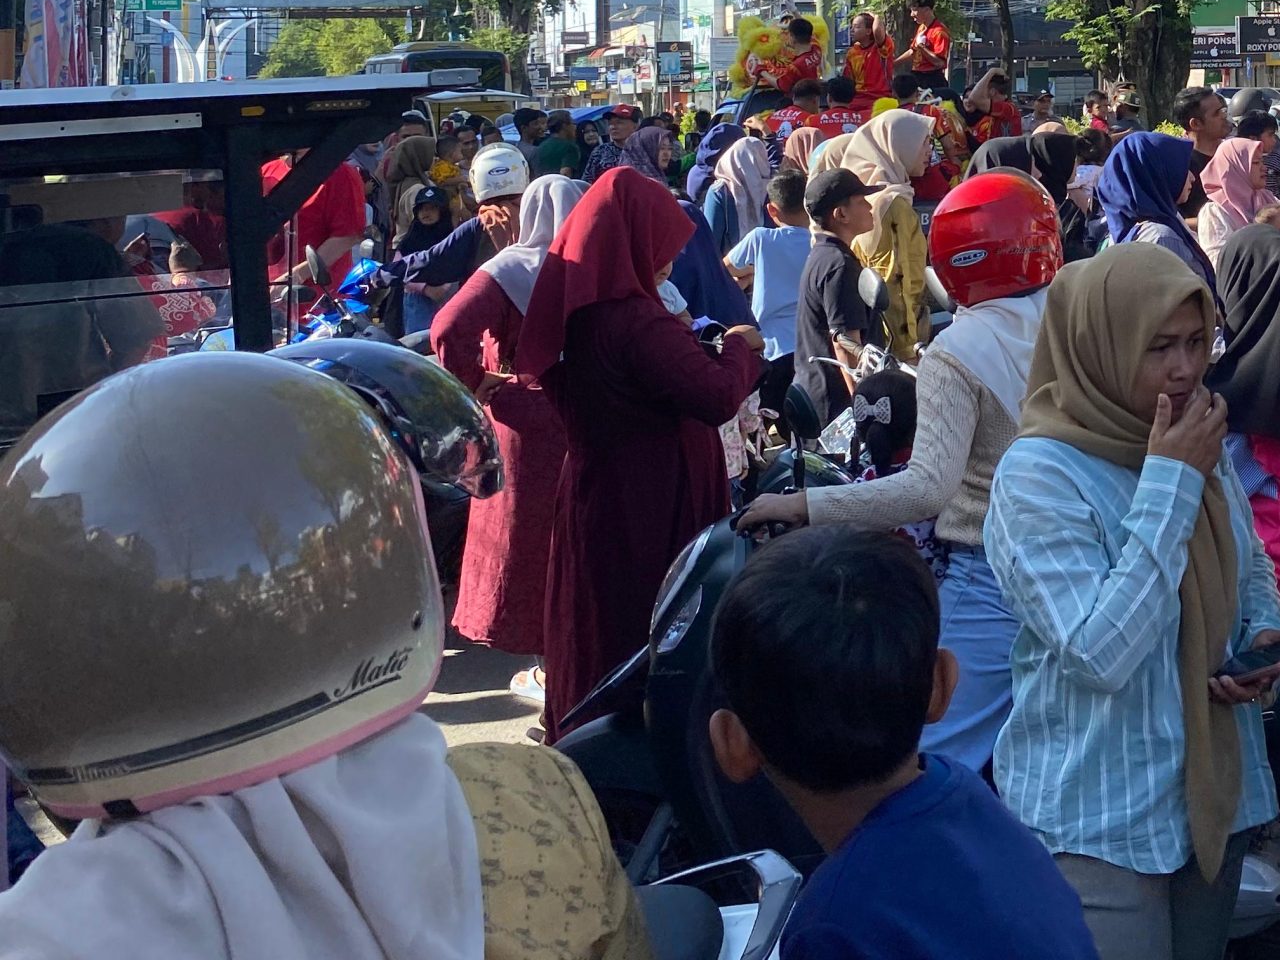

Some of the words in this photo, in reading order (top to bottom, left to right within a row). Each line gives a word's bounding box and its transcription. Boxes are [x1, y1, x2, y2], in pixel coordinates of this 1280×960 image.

[1208, 37, 1236, 45] PONSE
[804, 51, 819, 66] ACE
[773, 110, 802, 118] ACEH
[334, 647, 413, 698] Matic
